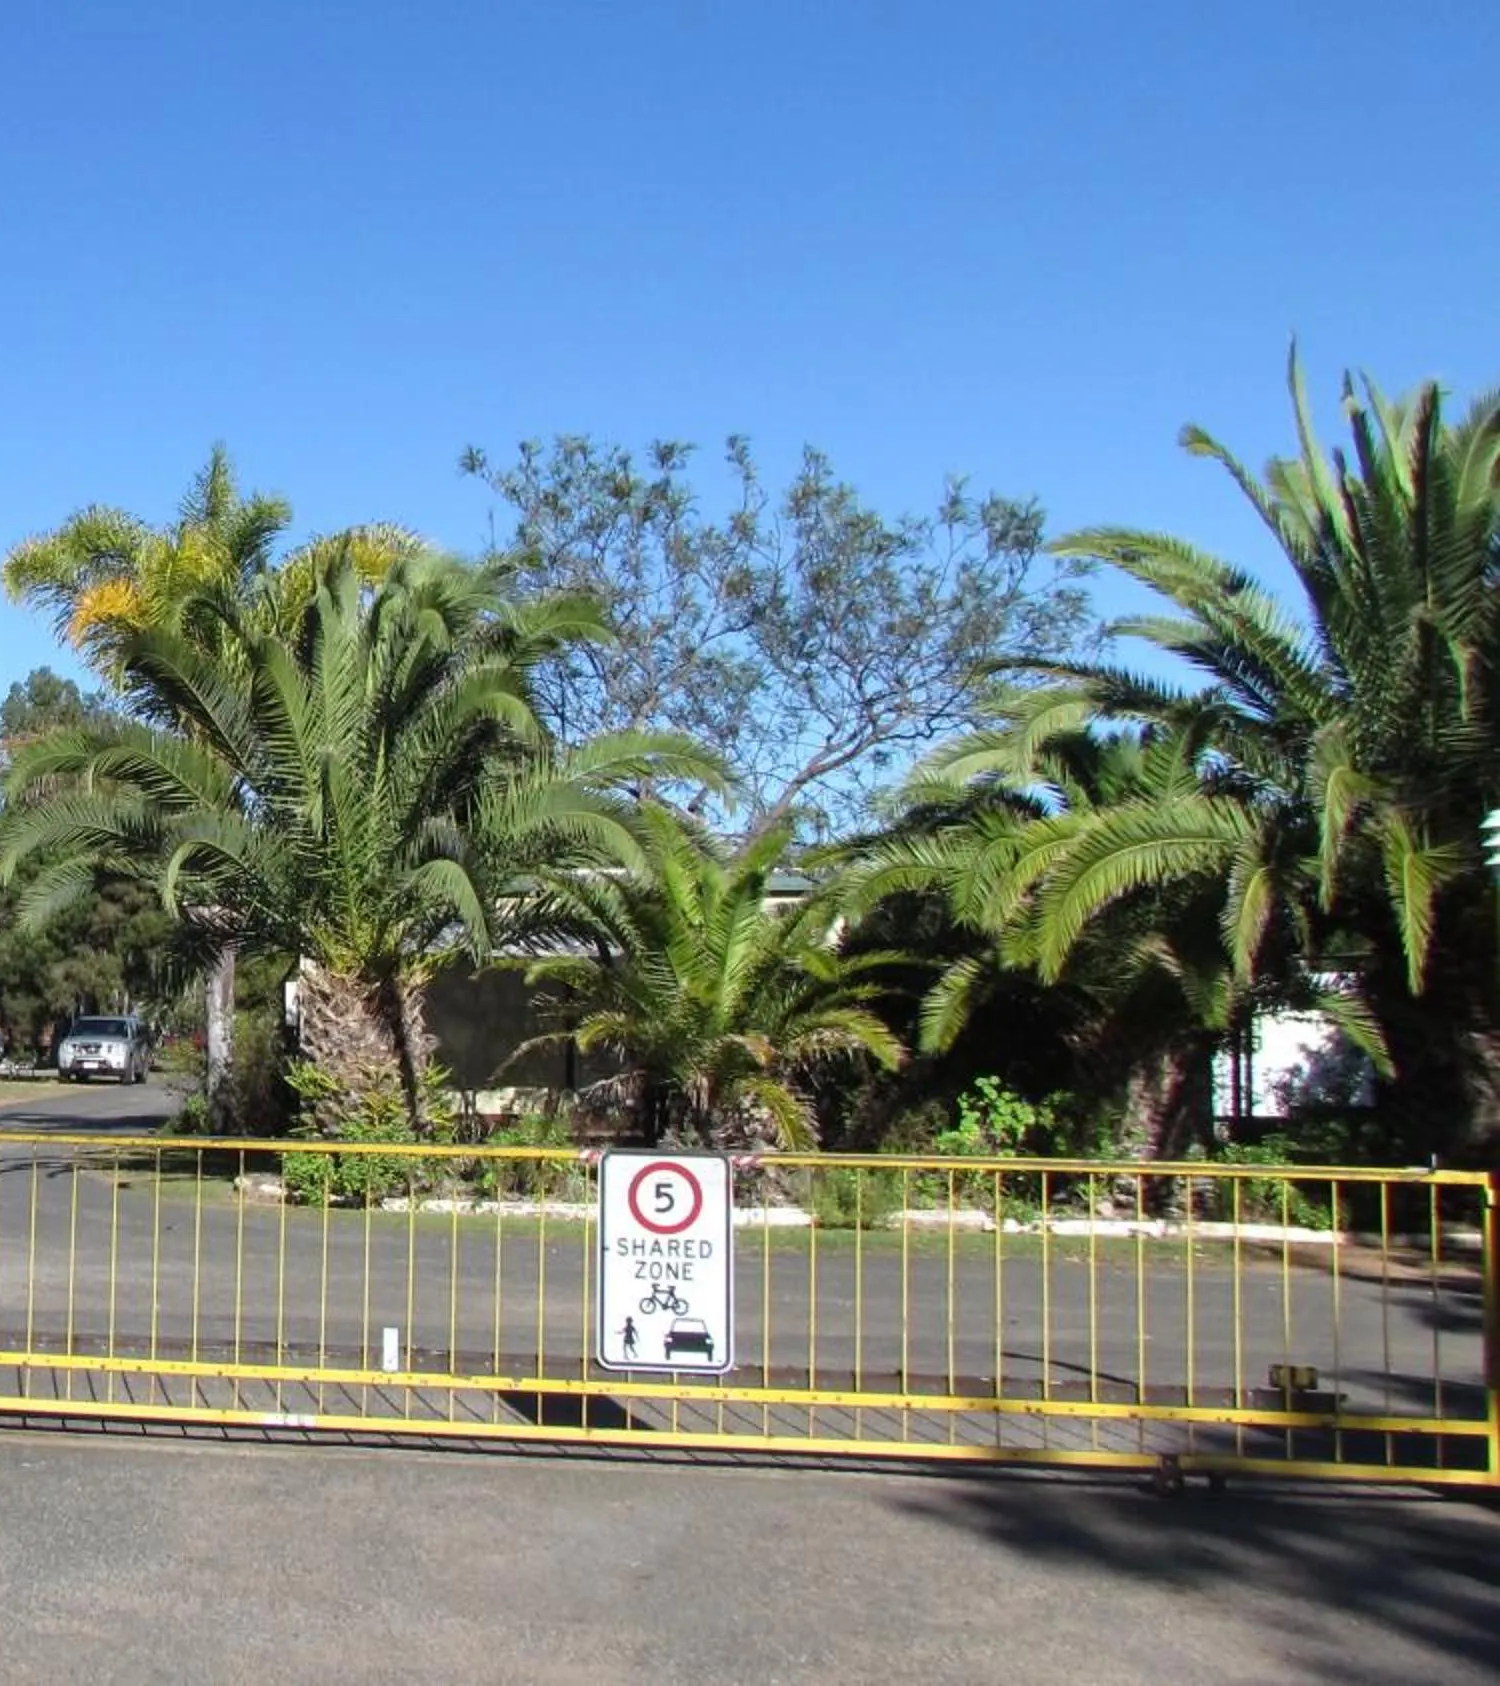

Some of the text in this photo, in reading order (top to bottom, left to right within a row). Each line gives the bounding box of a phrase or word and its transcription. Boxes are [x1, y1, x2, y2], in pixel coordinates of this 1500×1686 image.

[654, 1182, 675, 1214] 5
[616, 1237, 713, 1259] SHARED
[633, 1260, 694, 1282] ZONE
